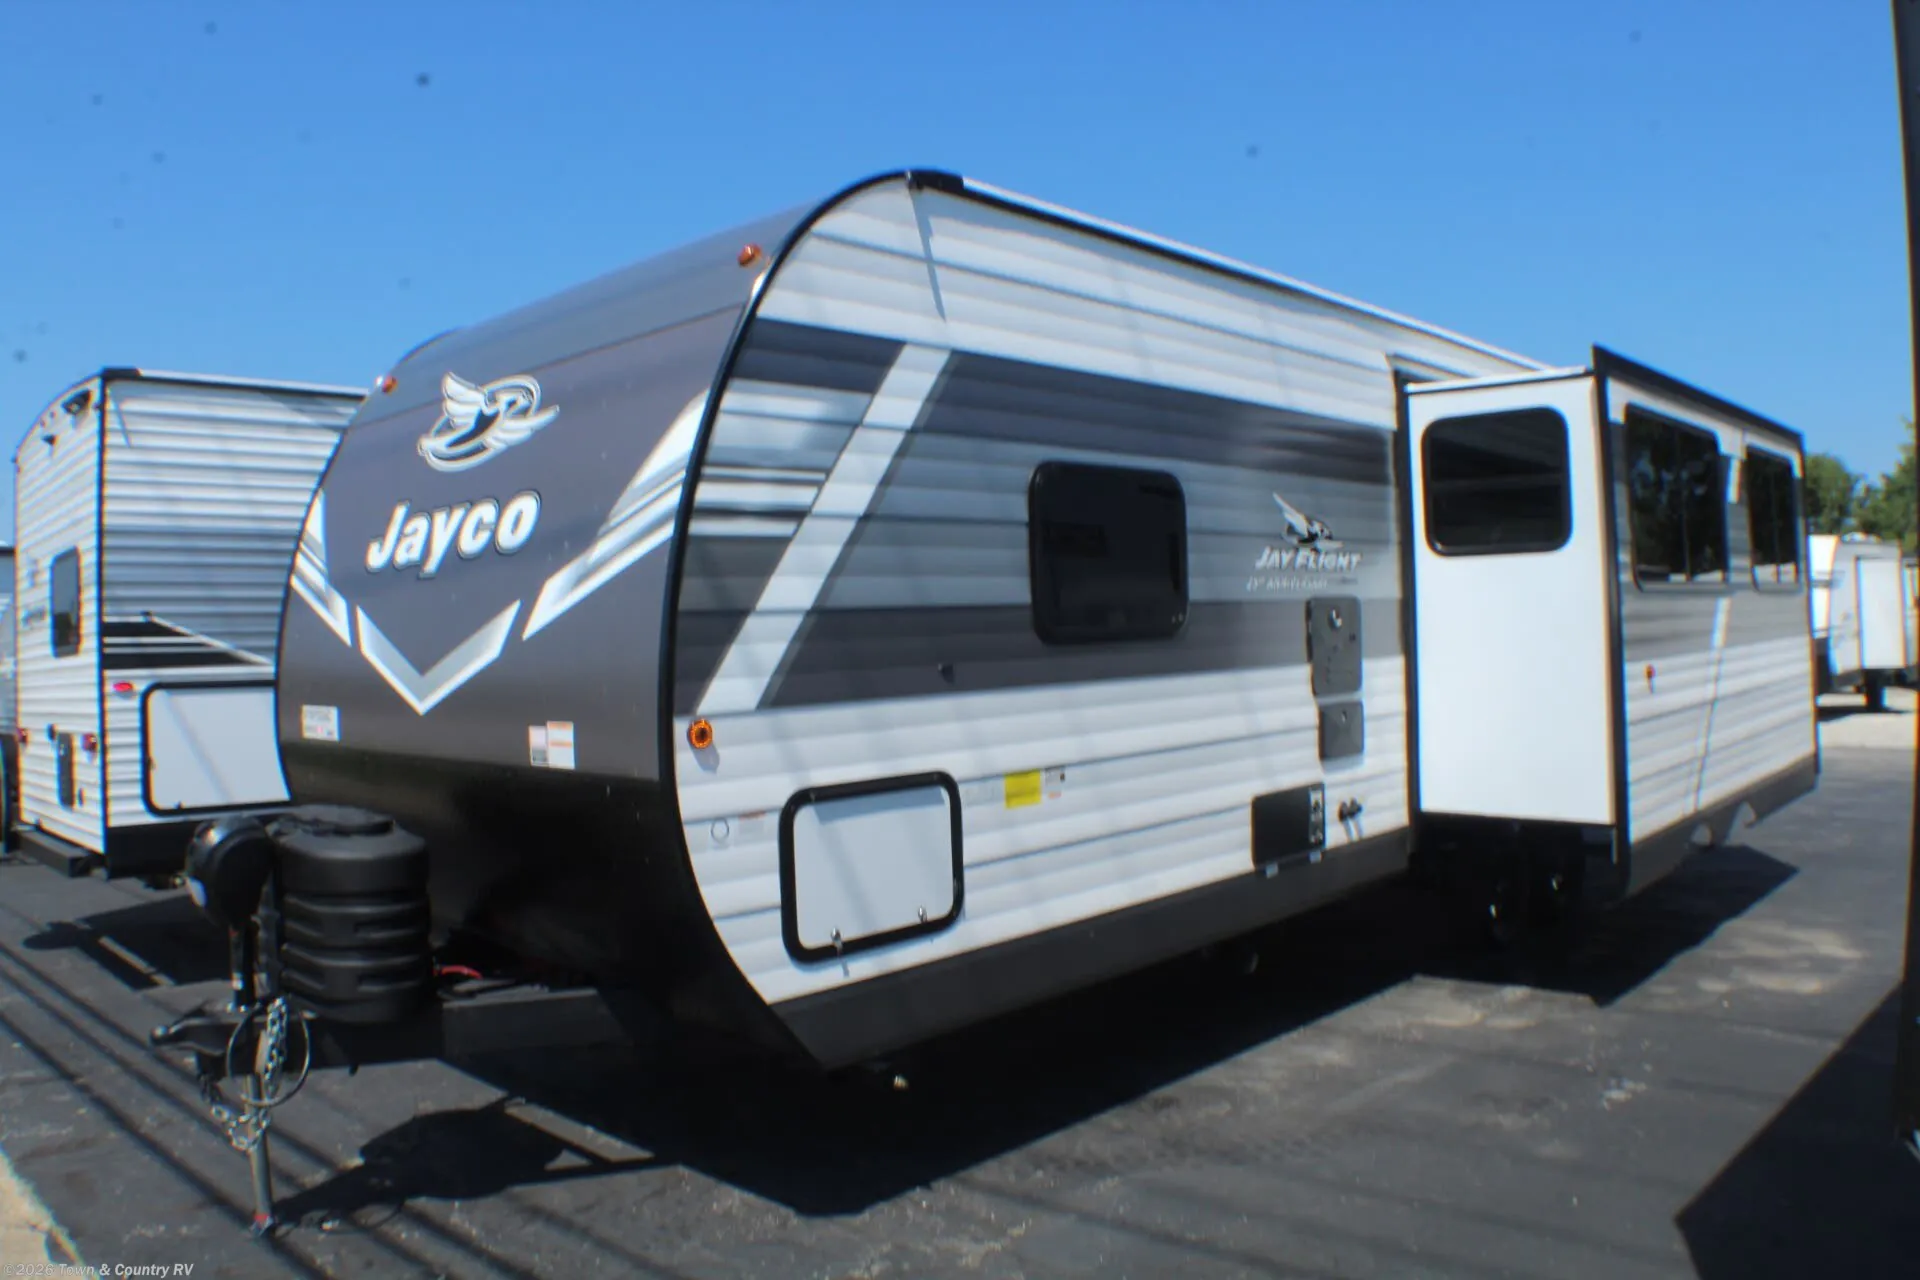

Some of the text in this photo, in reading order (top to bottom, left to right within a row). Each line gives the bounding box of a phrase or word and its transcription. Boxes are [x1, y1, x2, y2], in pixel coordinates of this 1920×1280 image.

[366, 490, 541, 579] Jayco
[1255, 546, 1362, 571] JAY FLIGHT
